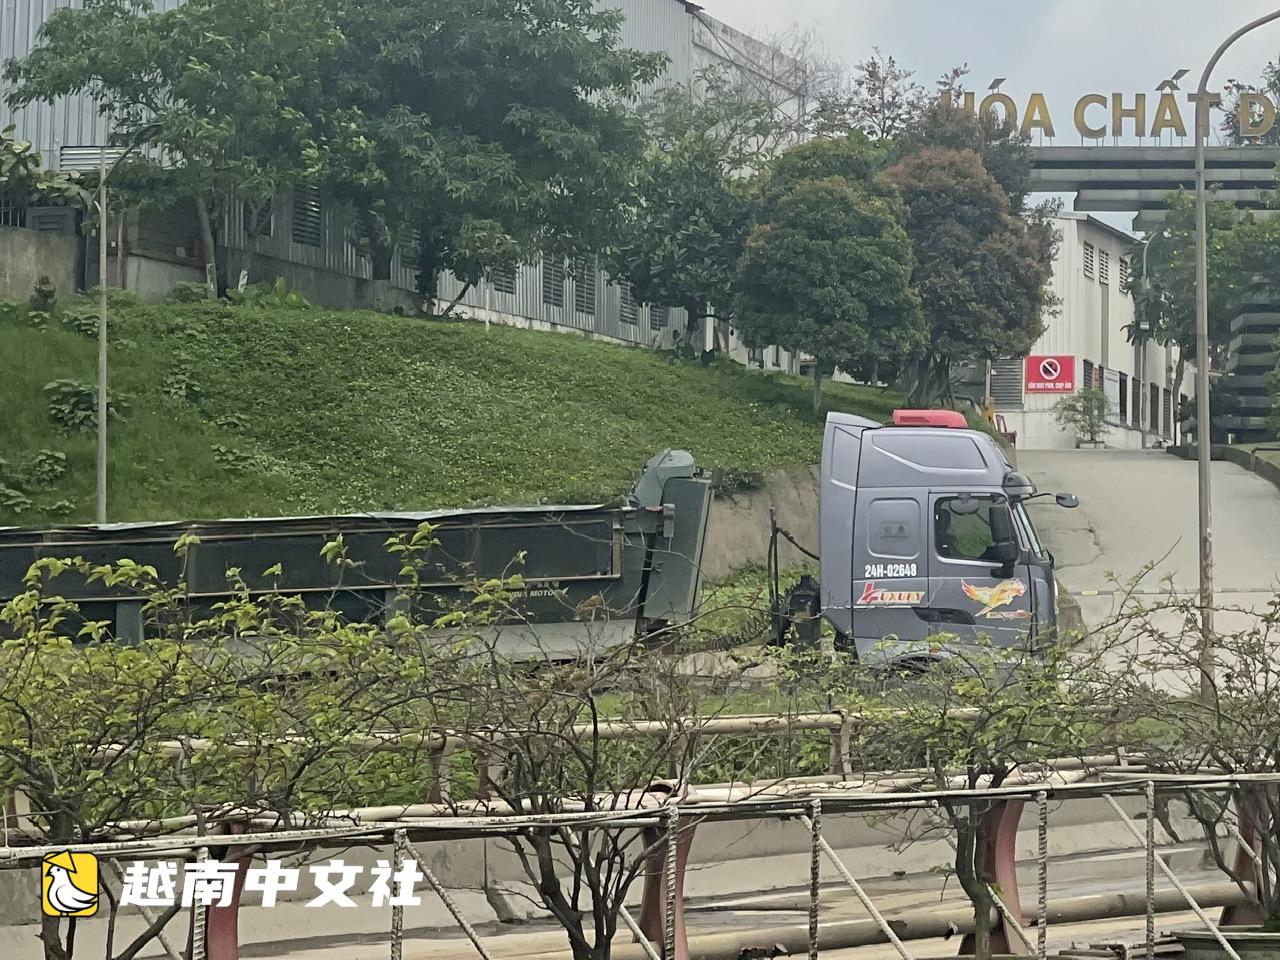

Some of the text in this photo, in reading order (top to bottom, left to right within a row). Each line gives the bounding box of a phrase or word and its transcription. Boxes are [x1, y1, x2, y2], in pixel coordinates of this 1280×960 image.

[1073, 69, 1221, 140] CHẤT
[864, 563, 917, 578] 24H-02648
[530, 589, 560, 598] MOTO
[858, 581, 926, 604] LUXURY
